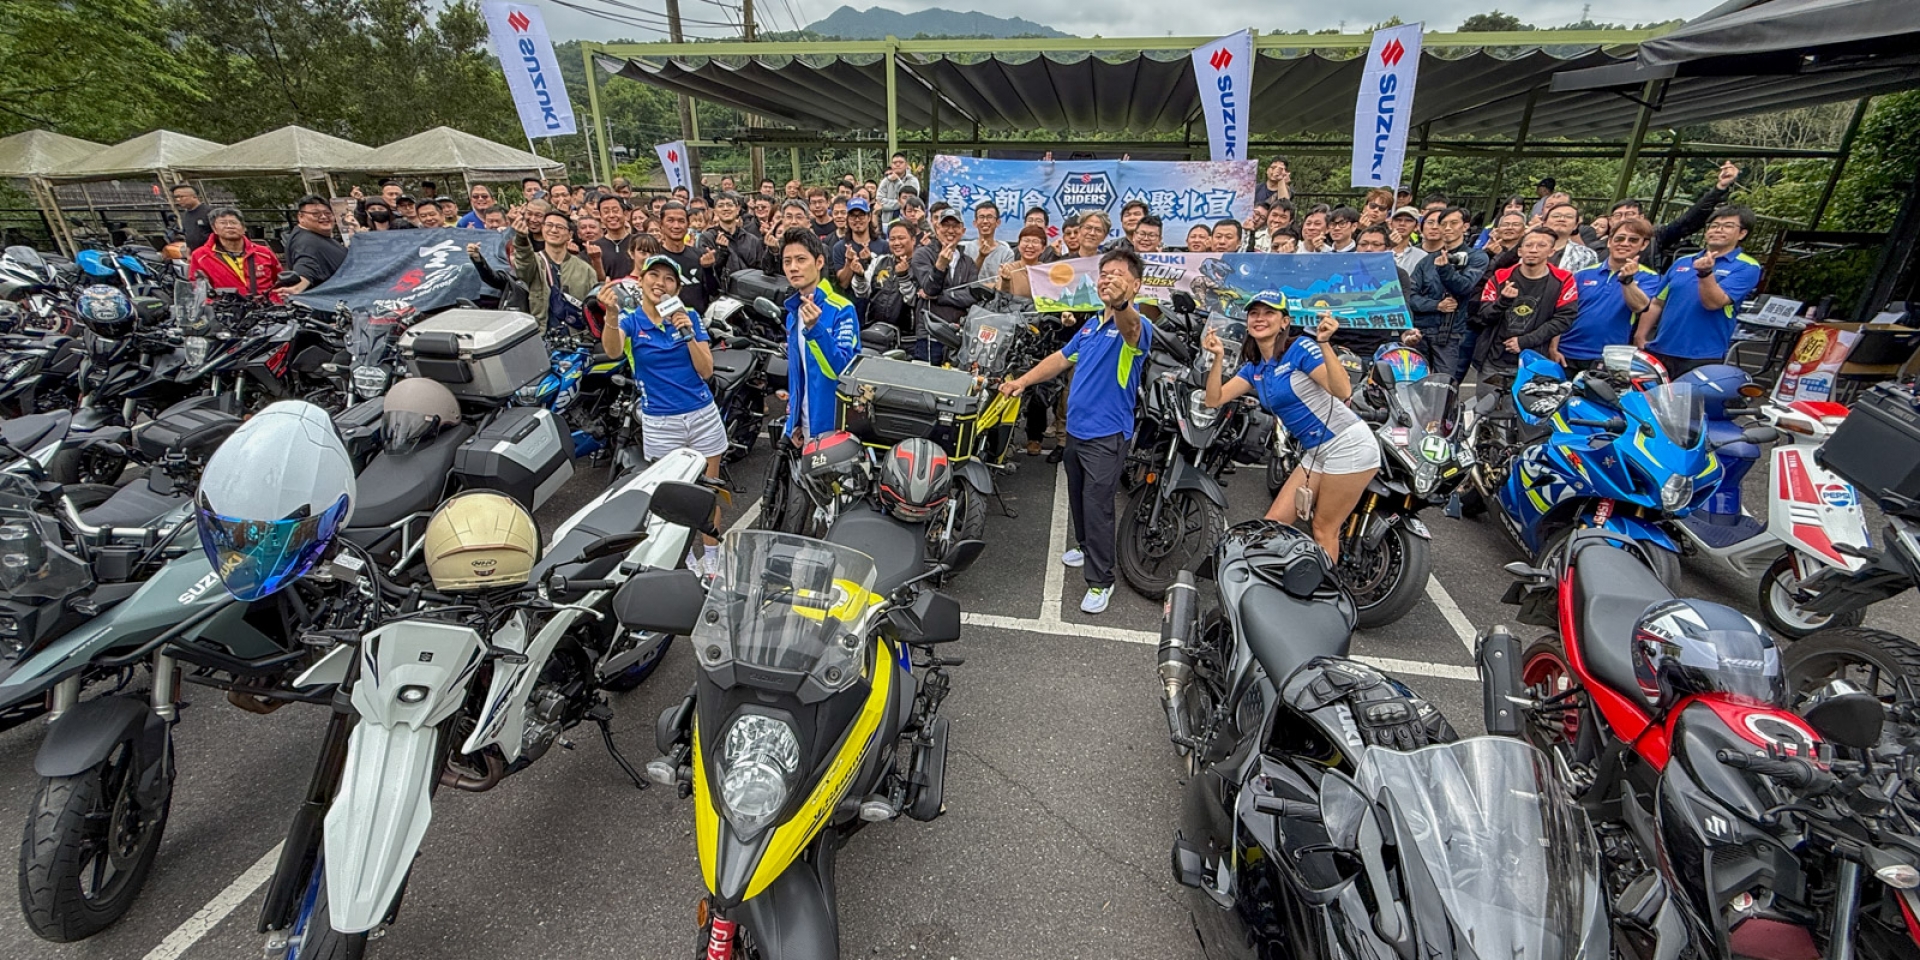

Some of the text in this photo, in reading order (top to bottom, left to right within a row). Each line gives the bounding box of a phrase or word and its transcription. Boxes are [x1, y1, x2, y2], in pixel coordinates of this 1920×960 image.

[1217, 74, 1237, 161] SUZUK
[1371, 73, 1398, 181] SUZUKI
[1063, 182, 1107, 194] SUZUKI
[1063, 194, 1107, 205] RIDERS
